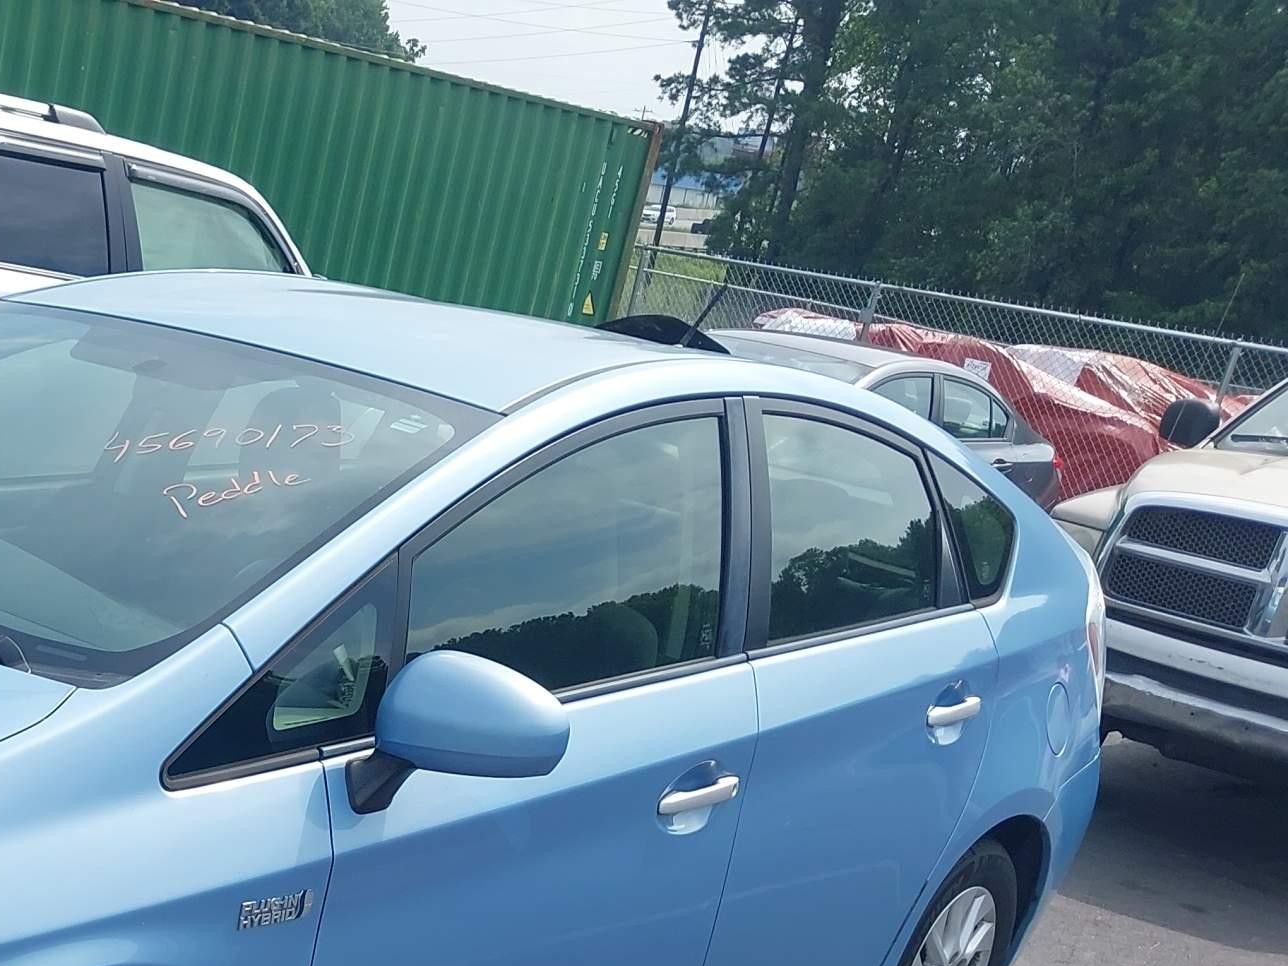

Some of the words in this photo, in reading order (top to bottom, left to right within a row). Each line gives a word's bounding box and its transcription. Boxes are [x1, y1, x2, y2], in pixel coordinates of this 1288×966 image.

[103, 423, 356, 463] 45690173
[162, 470, 312, 520] Peddle
[239, 907, 296, 930] HYBRID
